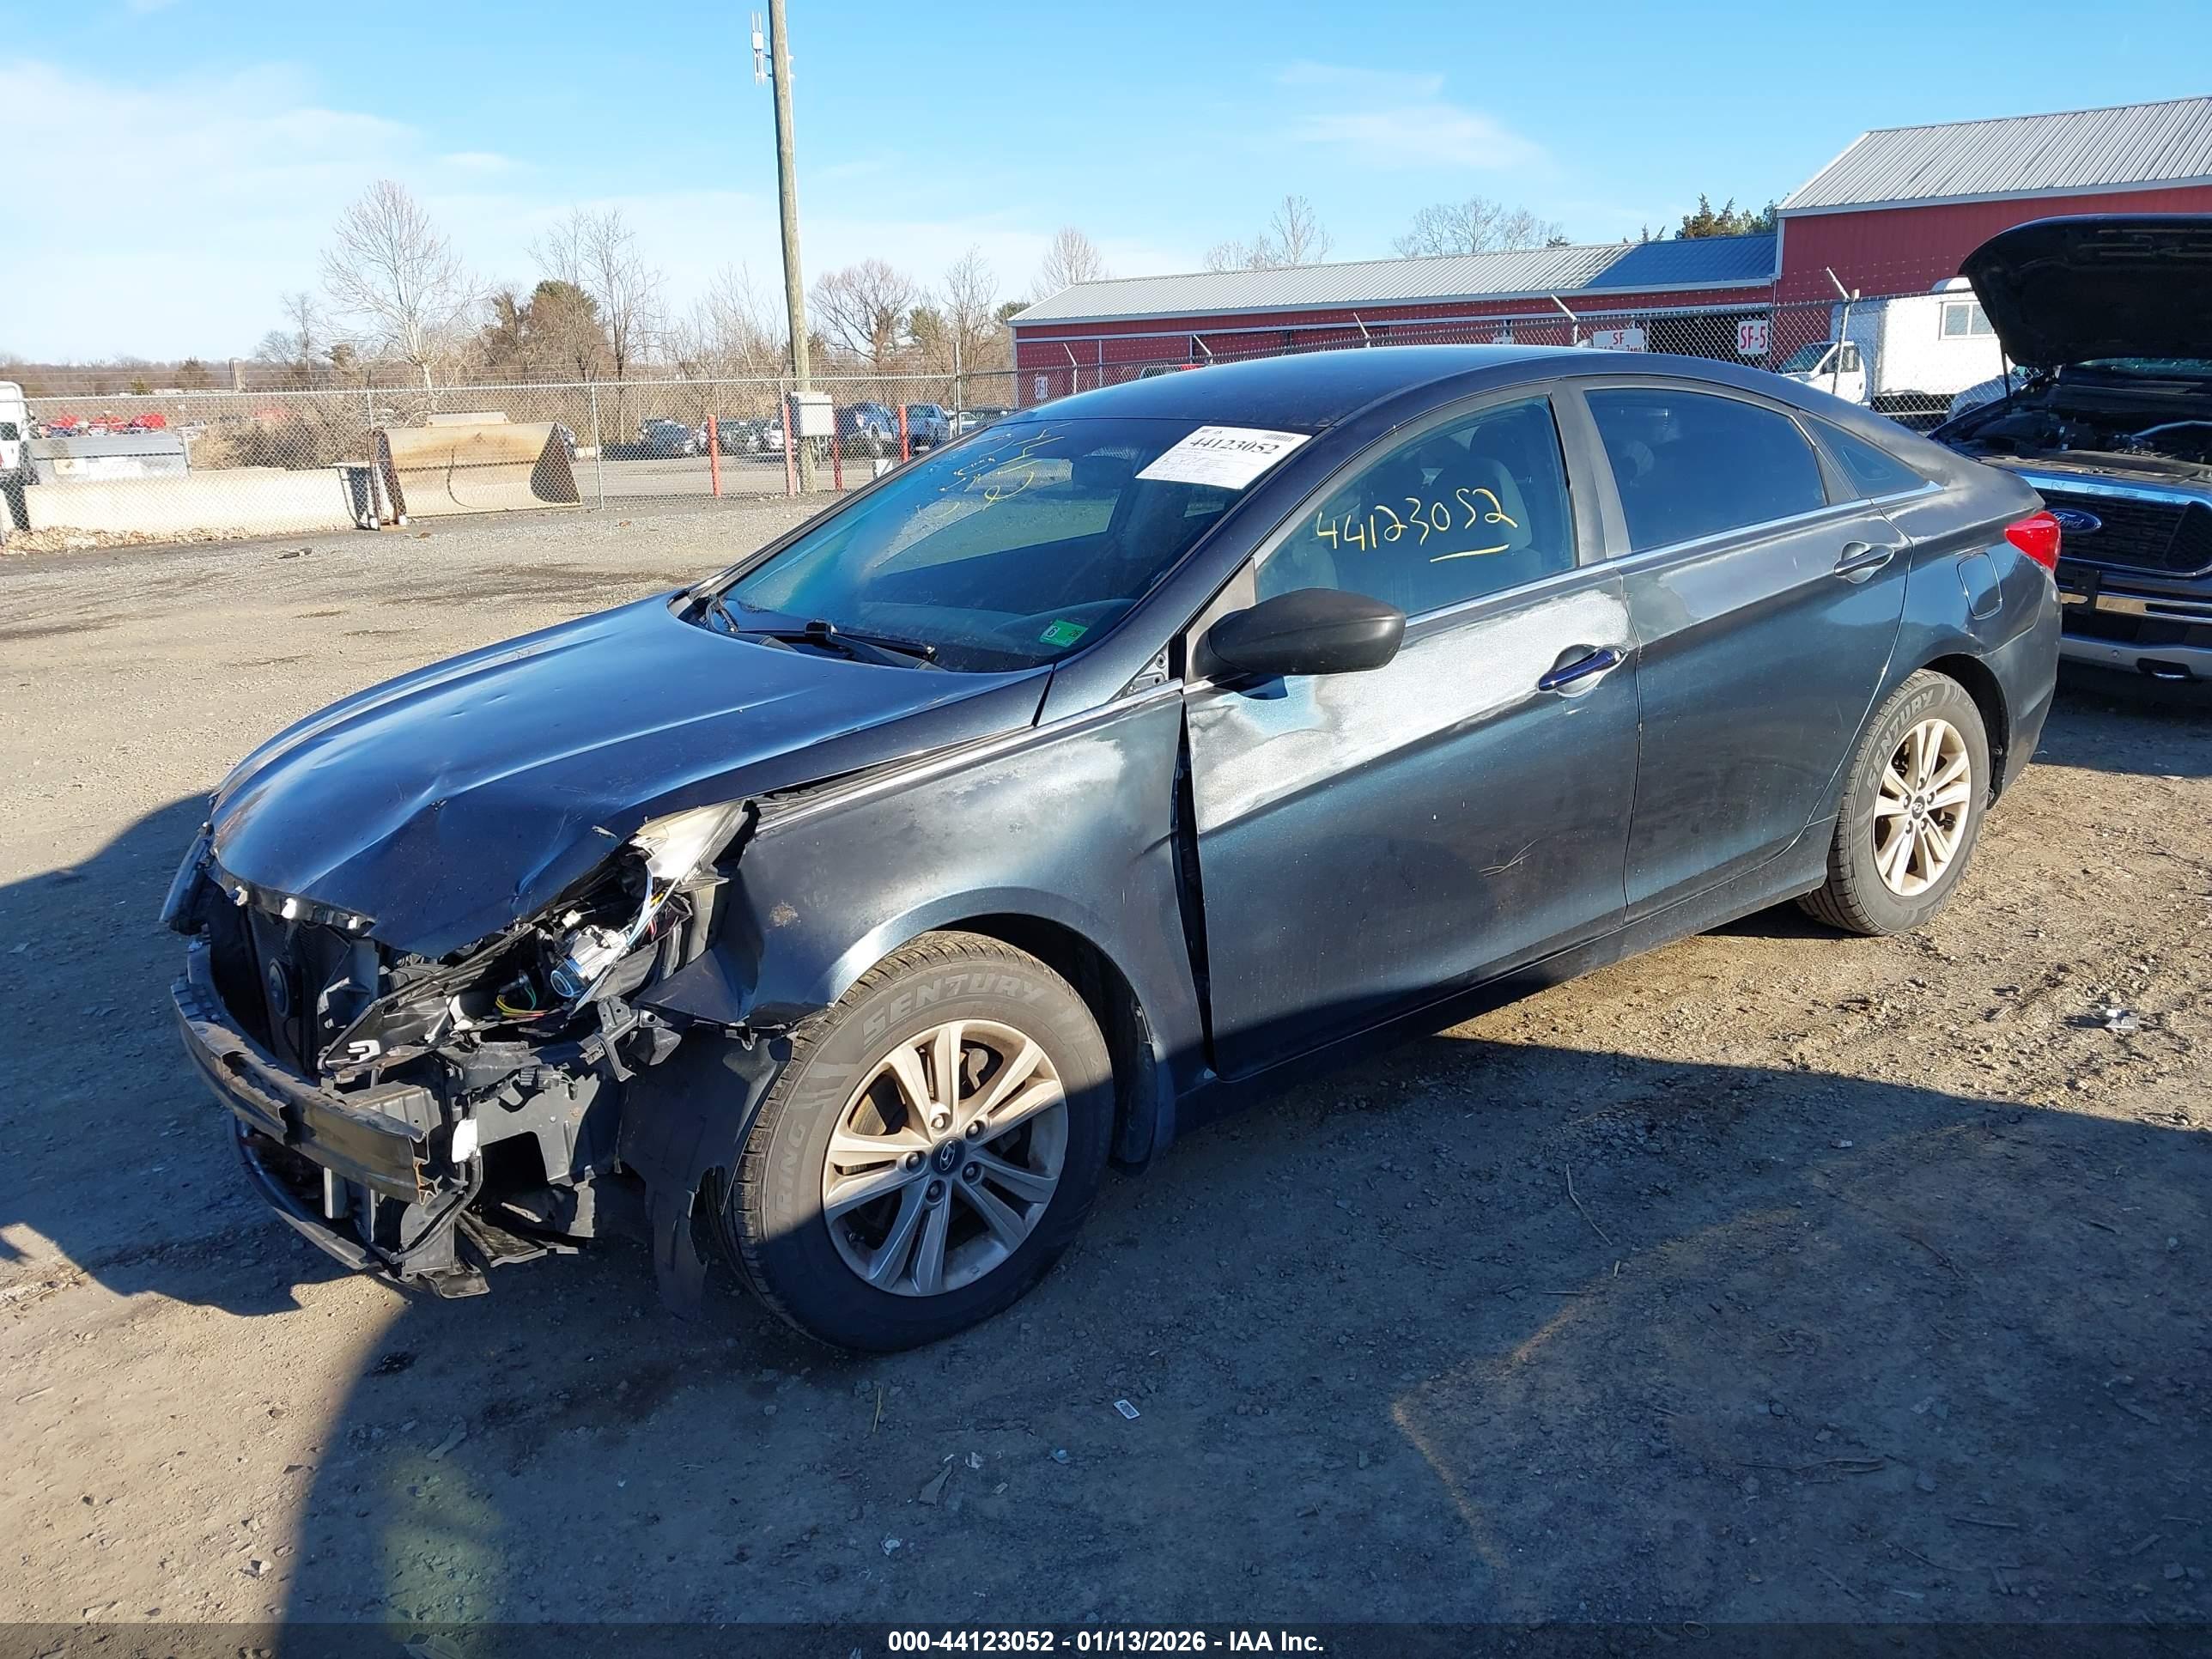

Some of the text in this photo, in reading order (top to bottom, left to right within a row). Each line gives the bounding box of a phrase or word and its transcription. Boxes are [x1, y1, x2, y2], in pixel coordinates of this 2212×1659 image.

[1613, 331, 1625, 345] SF
[1740, 325, 1766, 349] SF-5
[1190, 437, 1280, 454] 44123052
[1316, 488, 1518, 551] 44123052
[1867, 690, 1935, 791] SENTURY
[862, 973, 1047, 1051] SENTURY
